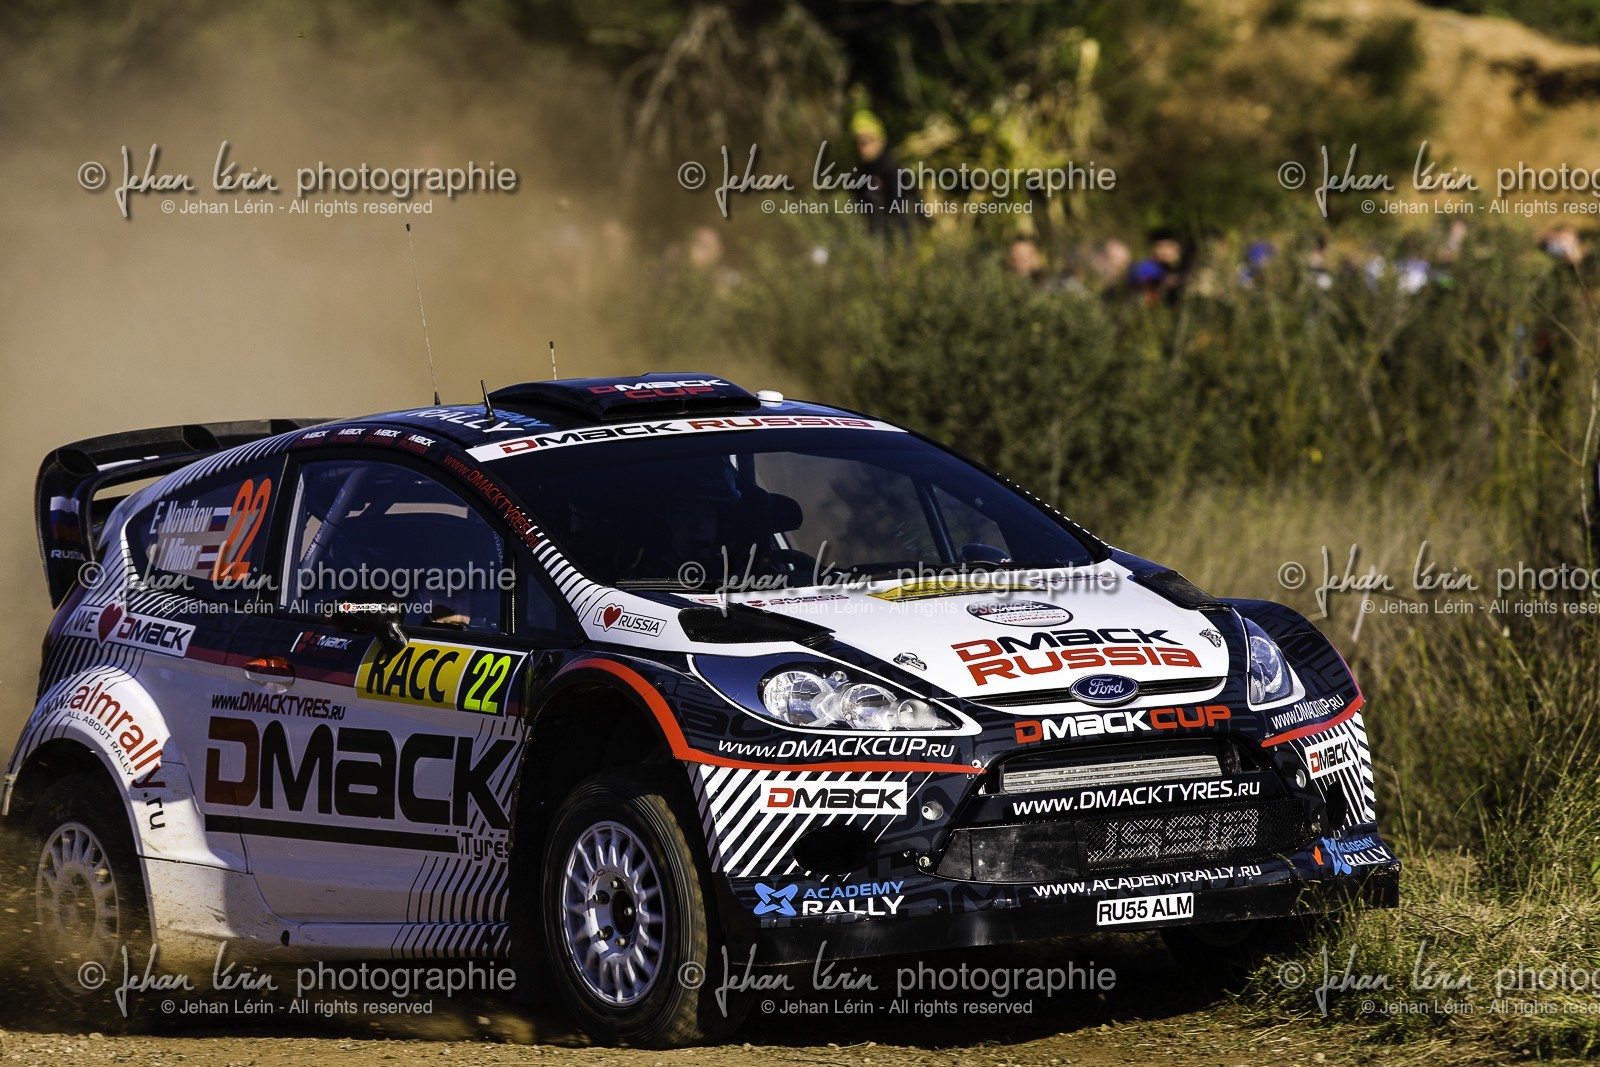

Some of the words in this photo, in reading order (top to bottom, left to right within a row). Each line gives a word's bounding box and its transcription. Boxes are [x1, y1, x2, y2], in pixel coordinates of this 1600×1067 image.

[625, 386, 714, 399] CUP
[406, 409, 524, 433] RALLY
[161, 500, 213, 533] Novikov
[210, 478, 272, 580] 22
[50, 549, 86, 562] RUSSIA
[162, 538, 201, 570] Minor
[618, 615, 660, 633] RUSSIA
[365, 646, 459, 703] RACC
[464, 653, 511, 714] 22
[1088, 678, 1124, 696] Ford
[66, 711, 81, 721] ALL
[83, 716, 112, 740] ABOUT
[110, 741, 134, 776] RALLY
[461, 832, 510, 861] Tyres
[1338, 836, 1377, 853] ACADEMY
[1343, 846, 1391, 867] RALLY
[803, 880, 905, 899] ACADEMY
[802, 895, 905, 917] RALLY
[1098, 900, 1148, 923] RU55
[1151, 896, 1193, 918] ALM
